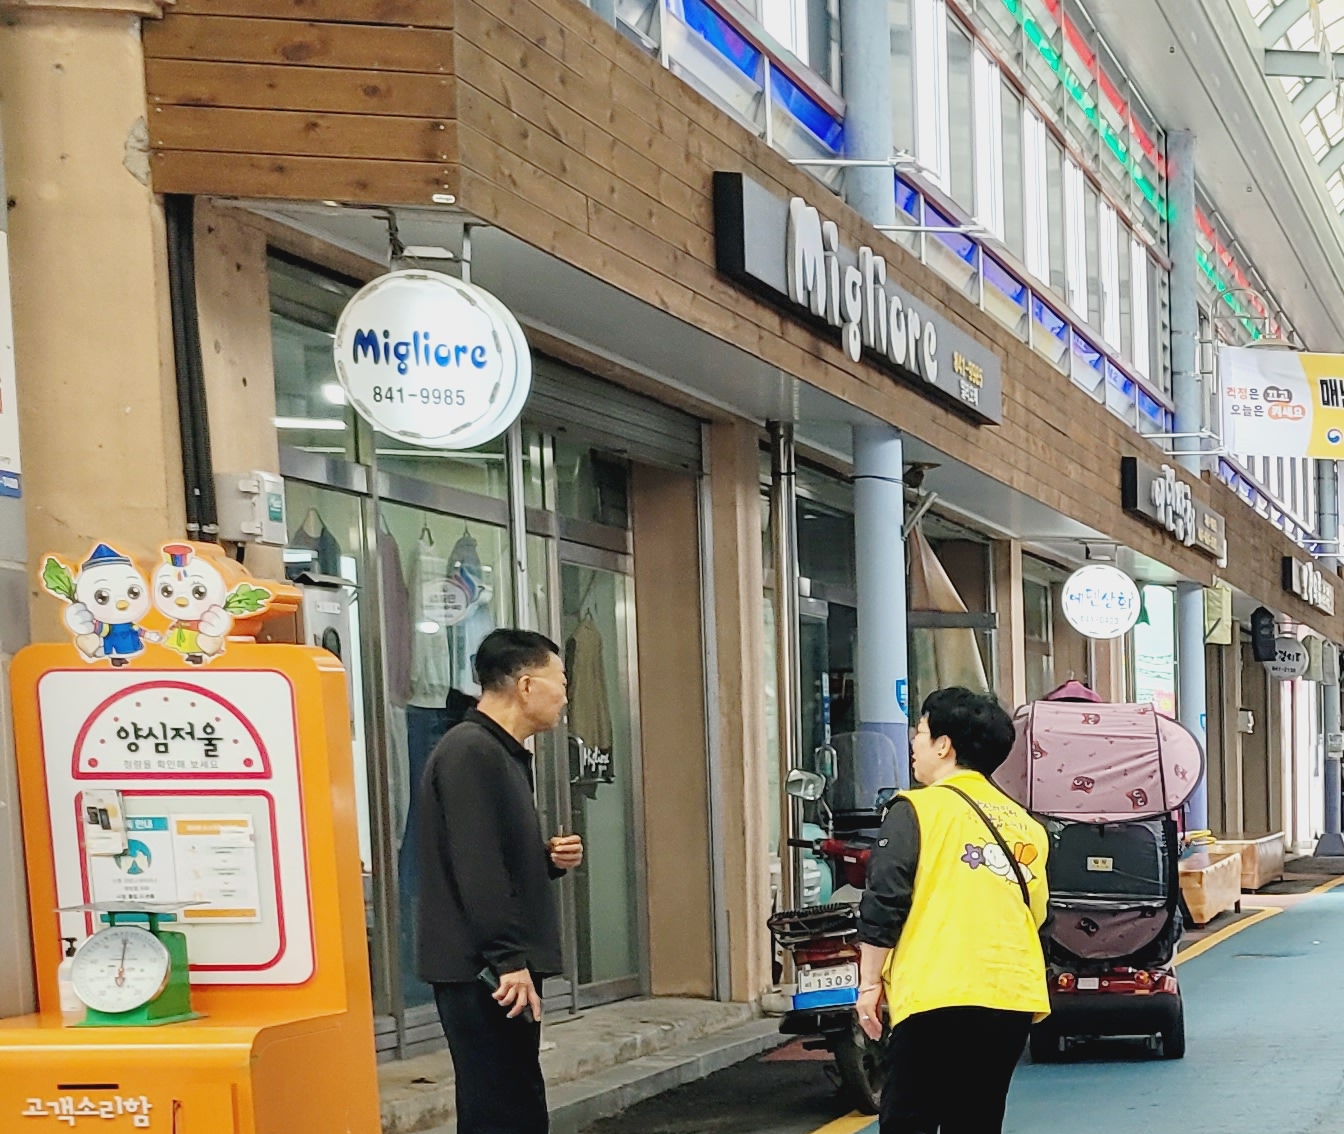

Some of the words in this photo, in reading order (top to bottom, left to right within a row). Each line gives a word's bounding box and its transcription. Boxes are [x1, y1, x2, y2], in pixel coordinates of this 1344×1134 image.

[787, 197, 938, 384] Migliore
[353, 328, 487, 375] Migliore
[373, 385, 466, 405] 841-9985
[1226, 386, 1259, 401] 걱정은
[1230, 404, 1264, 417] 오늘은
[117, 722, 223, 757] 양심저울
[817, 974, 853, 989] 1309
[21, 1095, 153, 1127] 고객소리함
